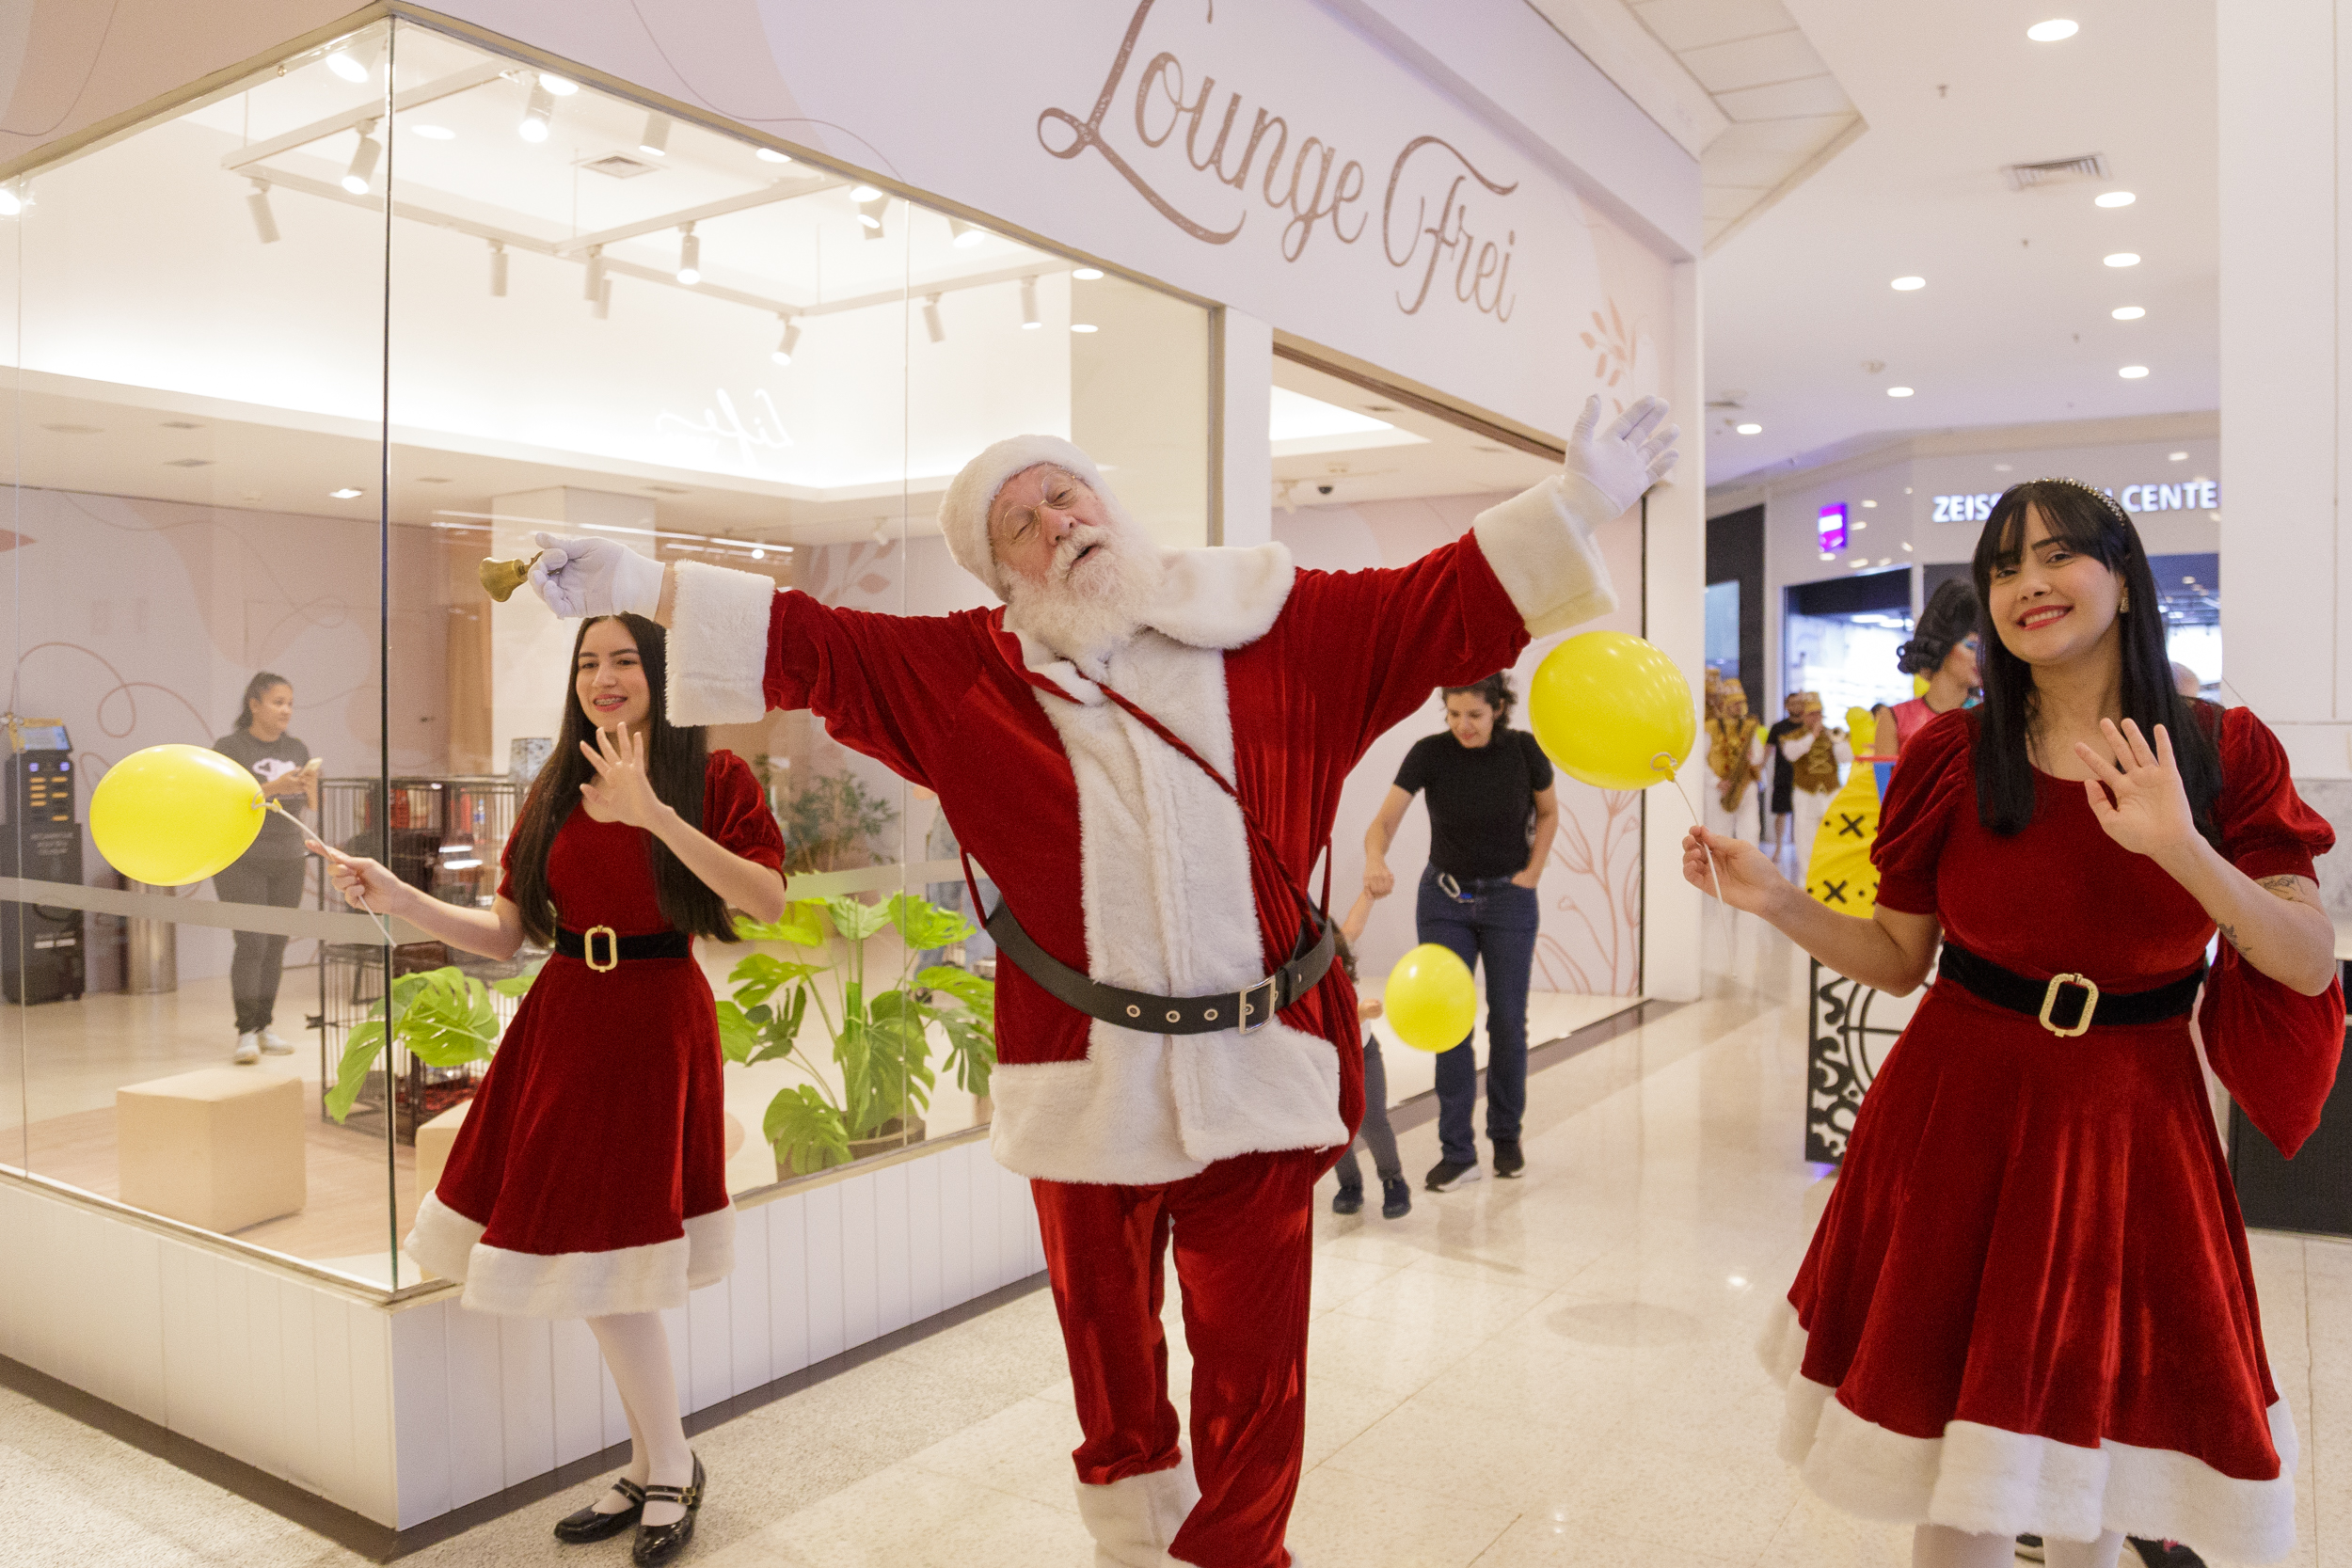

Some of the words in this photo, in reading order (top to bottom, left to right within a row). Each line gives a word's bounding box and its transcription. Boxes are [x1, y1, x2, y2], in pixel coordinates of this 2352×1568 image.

[1037, 0, 1369, 262] Lounge
[1383, 135, 1519, 323] Frei
[2121, 481, 2221, 513] CENTE
